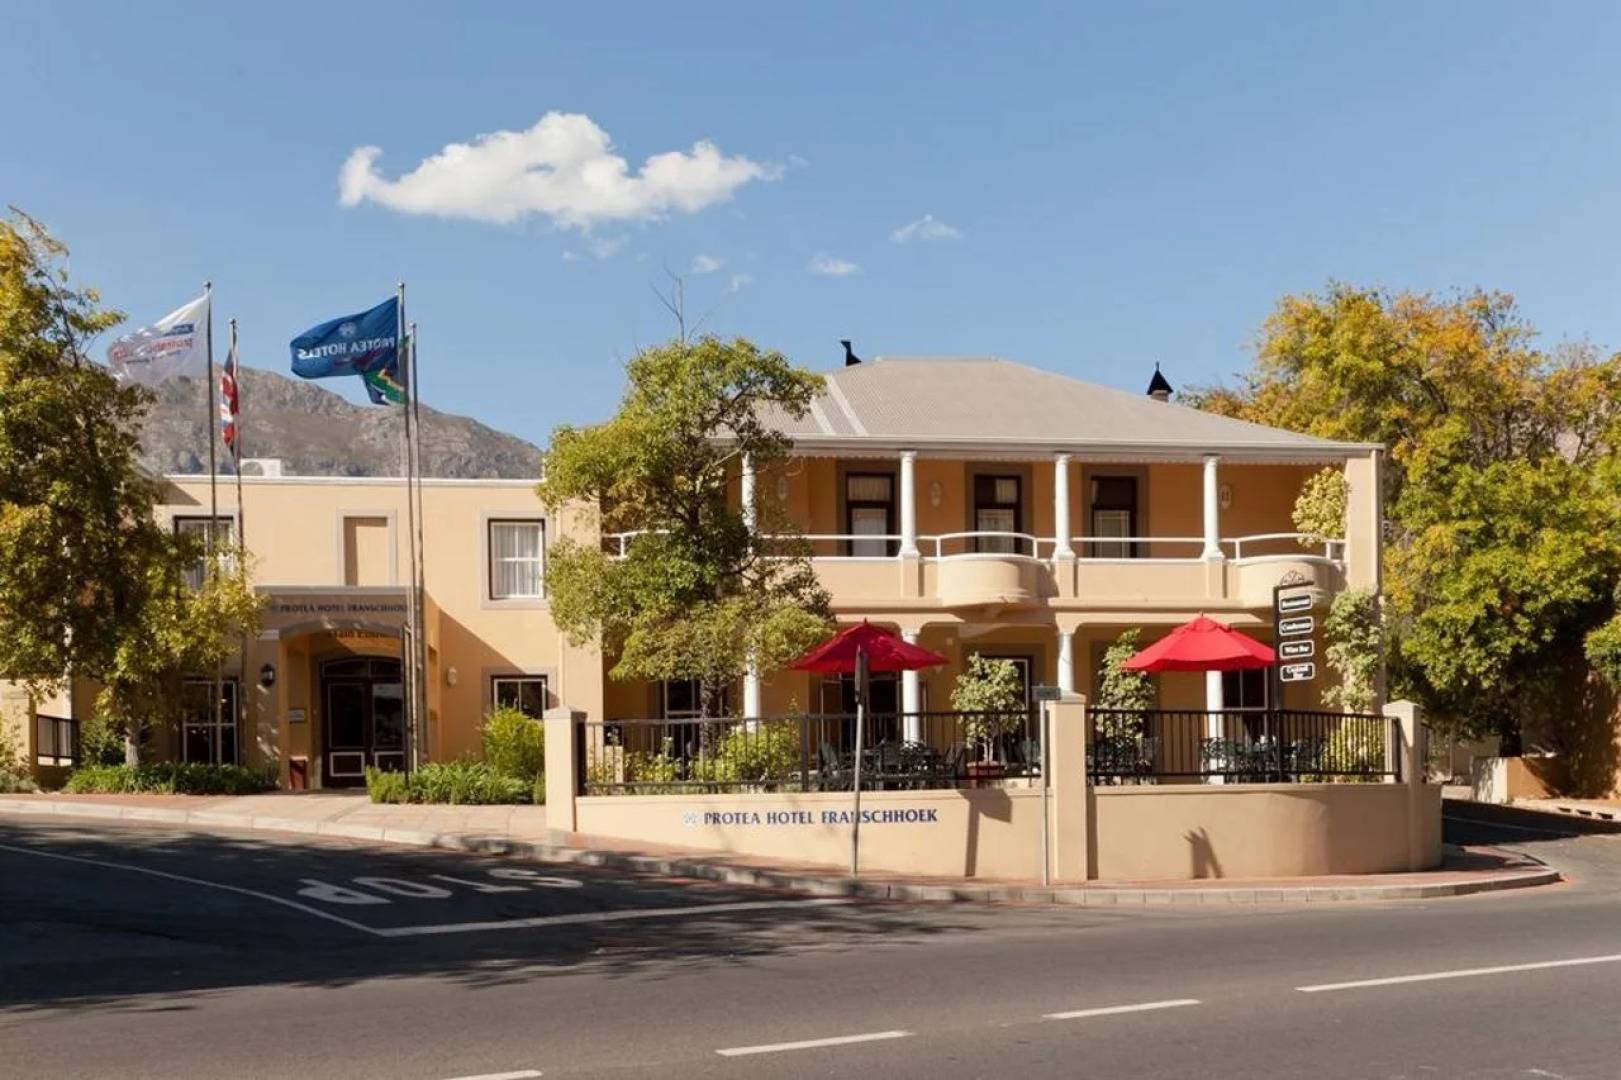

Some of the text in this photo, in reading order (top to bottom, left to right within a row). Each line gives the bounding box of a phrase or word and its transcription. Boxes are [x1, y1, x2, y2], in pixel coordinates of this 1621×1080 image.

[704, 812, 761, 826] PROTEA
[767, 811, 815, 825] HOTEL
[297, 868, 583, 904] STOP
